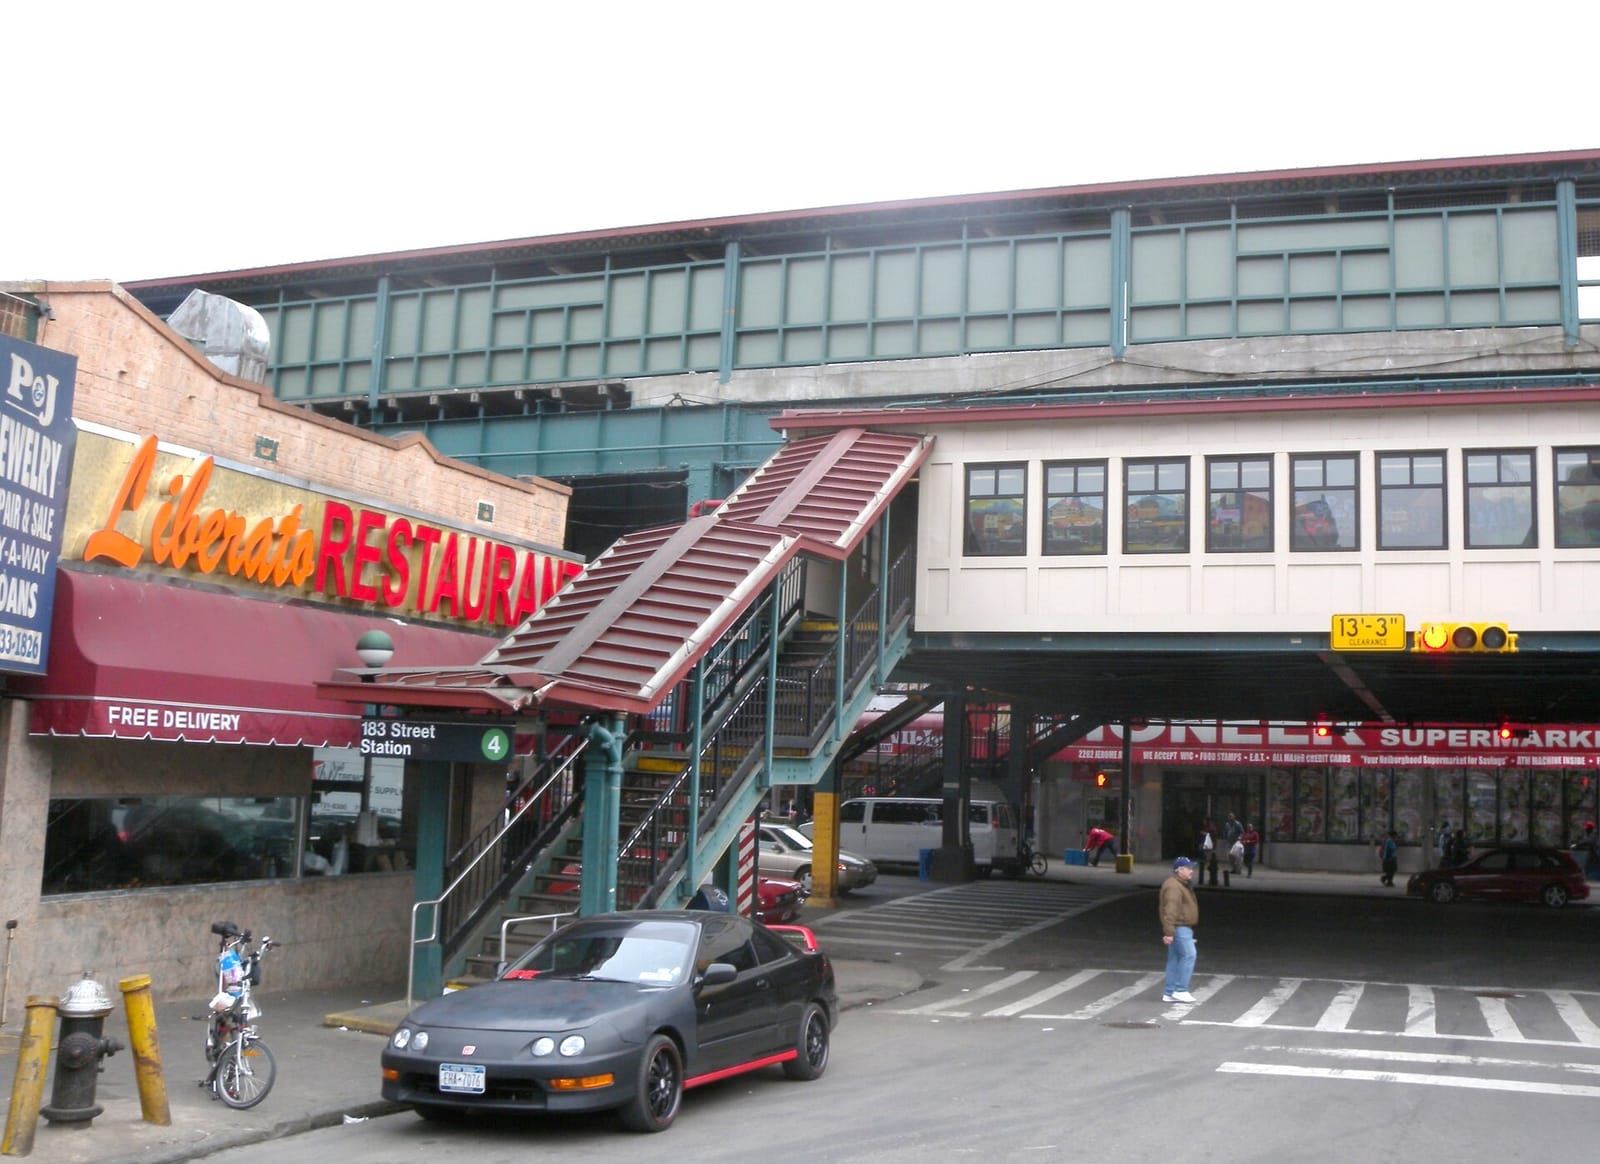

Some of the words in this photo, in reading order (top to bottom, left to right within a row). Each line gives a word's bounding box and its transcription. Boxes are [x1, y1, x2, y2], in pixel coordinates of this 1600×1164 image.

[84, 434, 315, 587] Liberato
[22, 498, 31, 533] &
[31, 502, 55, 542] SALE
[1349, 638, 1388, 646] CLEARANCE
[108, 706, 158, 726] FREE
[163, 710, 240, 731] DELIVERY
[361, 721, 386, 737] 183
[390, 722, 436, 739] Street
[360, 738, 412, 756] Station
[487, 735, 501, 754] 4
[1154, 751, 1177, 760] ACCEPT
